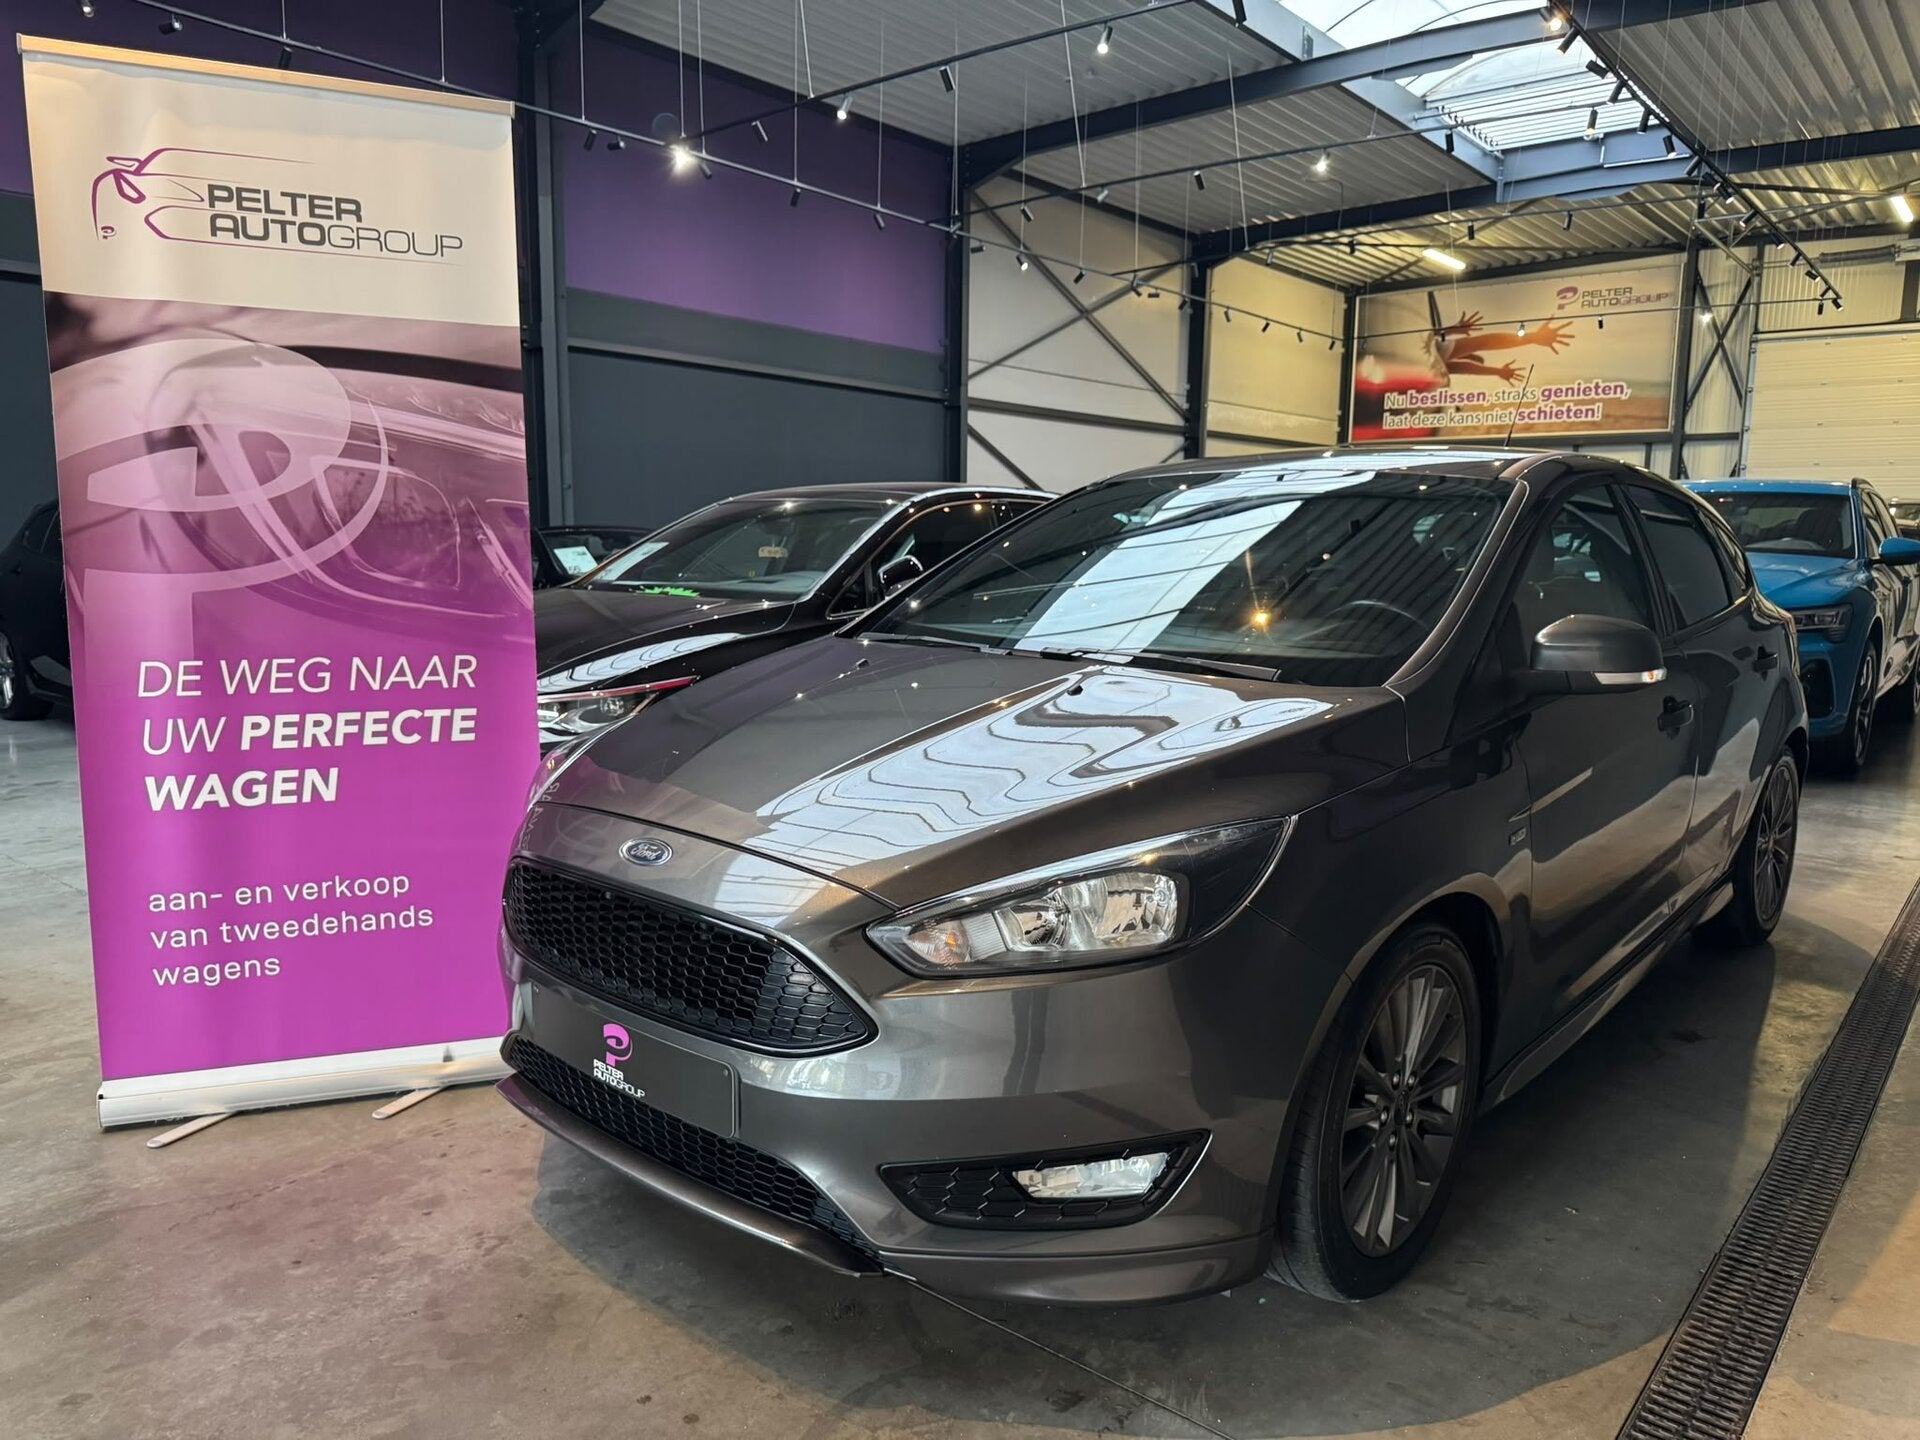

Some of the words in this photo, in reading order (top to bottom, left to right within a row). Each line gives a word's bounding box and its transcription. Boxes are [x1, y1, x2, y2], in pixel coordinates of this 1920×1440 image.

[207, 183, 363, 223] PELTER
[209, 213, 463, 257] AUTOGROUP
[1580, 292, 1669, 309] AUTOGROUP
[1581, 287, 1633, 299] PELTER
[1386, 394, 1405, 408] Nu
[1409, 390, 1490, 405] beslissen,
[1494, 389, 1537, 401] straks
[1540, 382, 1630, 402] genieten,
[1384, 411, 1408, 427] laat
[1412, 410, 1445, 426] deze
[1449, 411, 1481, 425] kans
[1485, 409, 1513, 423] niet
[1517, 404, 1601, 422] schieten!
[138, 660, 203, 698] DE
[220, 656, 331, 695] WEG
[350, 655, 477, 691] NAAR
[143, 716, 227, 755] UW
[240, 708, 477, 750] PERFECTE
[144, 767, 339, 812] WAGEN
[149, 890, 223, 913] aan-
[234, 885, 273, 906] en
[283, 875, 410, 902] verkoop
[150, 928, 208, 949] van
[219, 905, 434, 944] tweedehands
[152, 957, 281, 987] wagens
[593, 1058, 624, 1081] PELTER
[593, 1067, 646, 1098] AUTOGROUP
